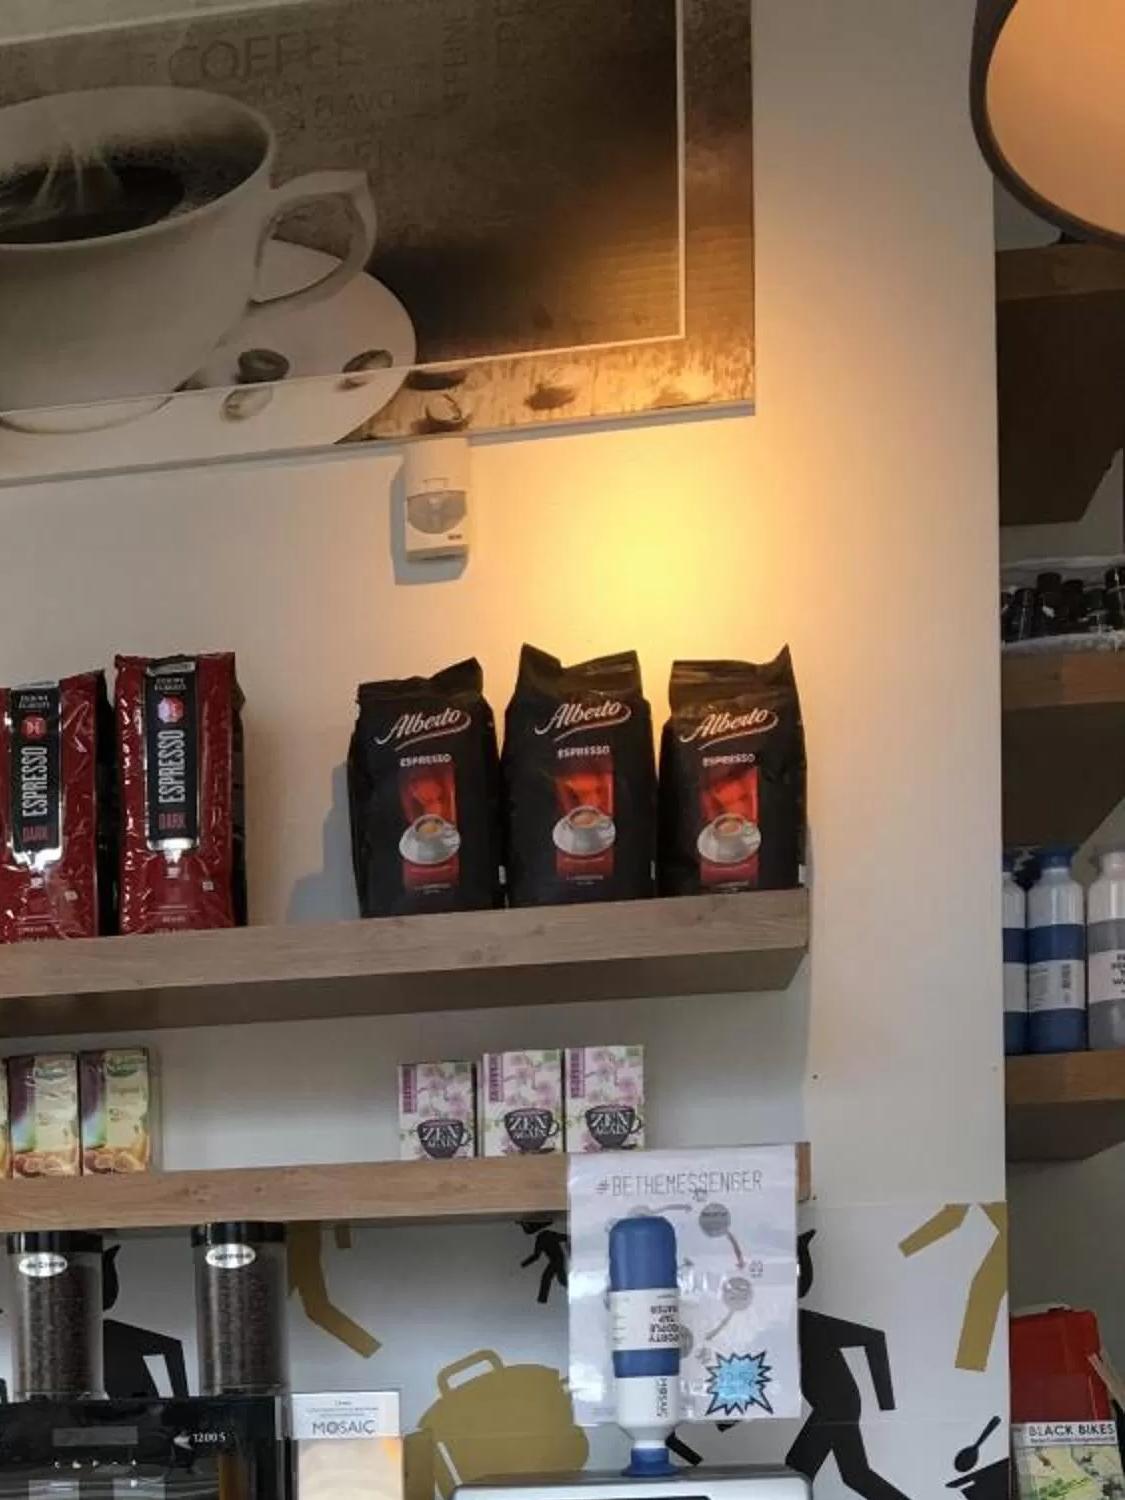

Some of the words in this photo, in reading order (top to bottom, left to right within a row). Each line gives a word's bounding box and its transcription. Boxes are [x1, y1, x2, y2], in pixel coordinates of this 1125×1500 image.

[375, 708, 471, 750] Alberto
[535, 700, 631, 742] Alberto
[679, 707, 778, 749] Alberto
[399, 754, 452, 767] ESPRESSO
[557, 745, 610, 759] ESPRESSO
[702, 753, 756, 767] ESPRESSO
[159, 730, 185, 804] ESPRESSO
[23, 746, 48, 817] ESPRESSO
[595, 1170, 764, 1197] #BETHEMESSENGER
[311, 1419, 376, 1435] MOSAIC
[1028, 1425, 1073, 1437] BLACK
[1078, 1423, 1115, 1435] BIKES
[193, 1433, 218, 1443] 1200
